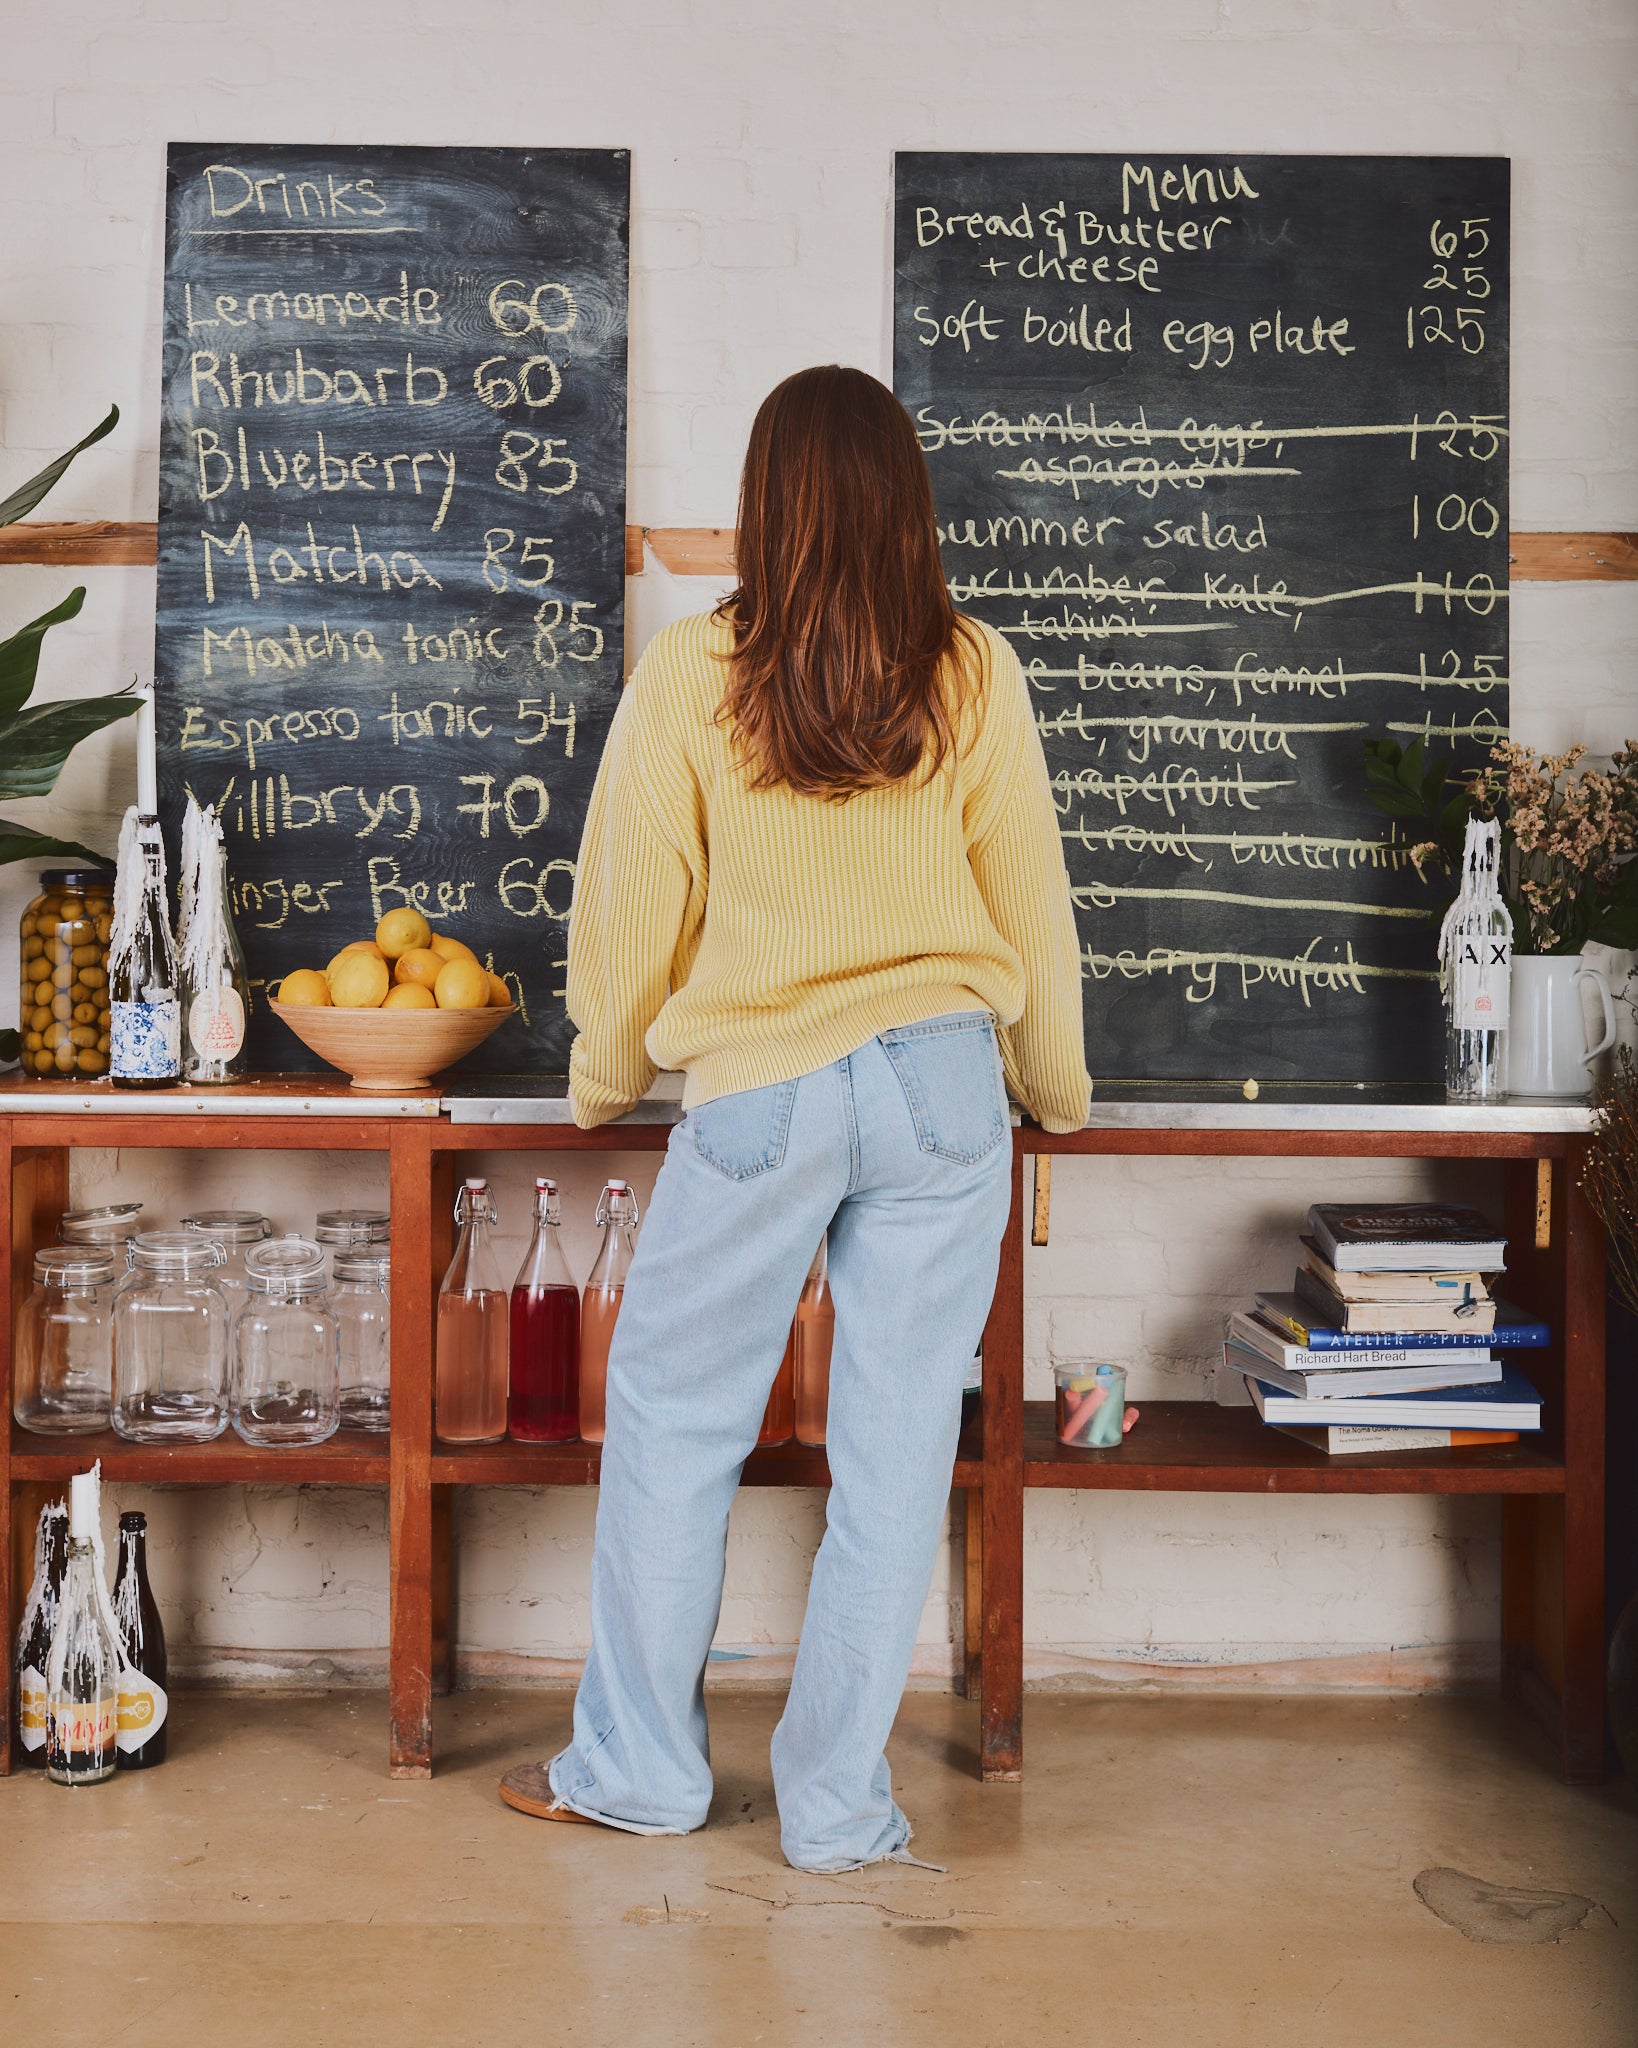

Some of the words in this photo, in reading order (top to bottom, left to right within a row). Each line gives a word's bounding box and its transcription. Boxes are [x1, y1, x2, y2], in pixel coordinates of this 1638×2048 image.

[203, 164, 387, 219] Drinks
[1123, 162, 1259, 214] Menu
[917, 202, 1034, 247] Bread
[1075, 211, 1231, 253] Butter
[1430, 218, 1491, 258] 65
[1018, 249, 1162, 293] cheese
[1423, 263, 1491, 299] 25
[185, 270, 441, 337] Lemonade
[488, 280, 579, 336] 60
[914, 299, 1004, 353] Soft
[1023, 303, 1132, 353] boiled
[1162, 320, 1235, 370] egg
[1250, 305, 1356, 356] plate
[1408, 305, 1486, 355] 125
[191, 348, 448, 408] Rhubarb
[473, 354, 562, 410] 60
[917, 403, 1153, 451] Scrambled
[1410, 411, 1506, 461] 125
[191, 425, 456, 532] Blueberry
[495, 430, 579, 495] 85
[1143, 511, 1267, 553] salad
[1413, 494, 1499, 538] 100
[201, 521, 443, 603] Matcha
[482, 527, 555, 594] 85
[950, 563, 1170, 614] ucumber,
[1415, 571, 1497, 615] 110
[201, 620, 384, 677] Matcha
[401, 616, 508, 664] tonic
[533, 599, 605, 669] 85
[1020, 604, 1149, 641] tahini
[1077, 653, 1217, 706] beans,
[1233, 652, 1347, 706] fennel
[1420, 649, 1504, 693] 125
[180, 706, 360, 771] Espresso
[378, 687, 494, 746] tonic
[514, 691, 577, 759] 54
[1128, 713, 1297, 764] granola
[1424, 708, 1500, 750] 110
[456, 771, 549, 840] 70
[1053, 761, 1262, 817] grapefruit
[177, 872, 344, 931] inger
[368, 856, 475, 923] Beer
[497, 857, 577, 921] 60
[1295, 1352, 1340, 1365] Richard
[1343, 1351, 1368, 1363] Hart
[1371, 1350, 1406, 1362] Bread
[1330, 1333, 1403, 1347] ATELIER
[1338, 1427, 1351, 1436] The
